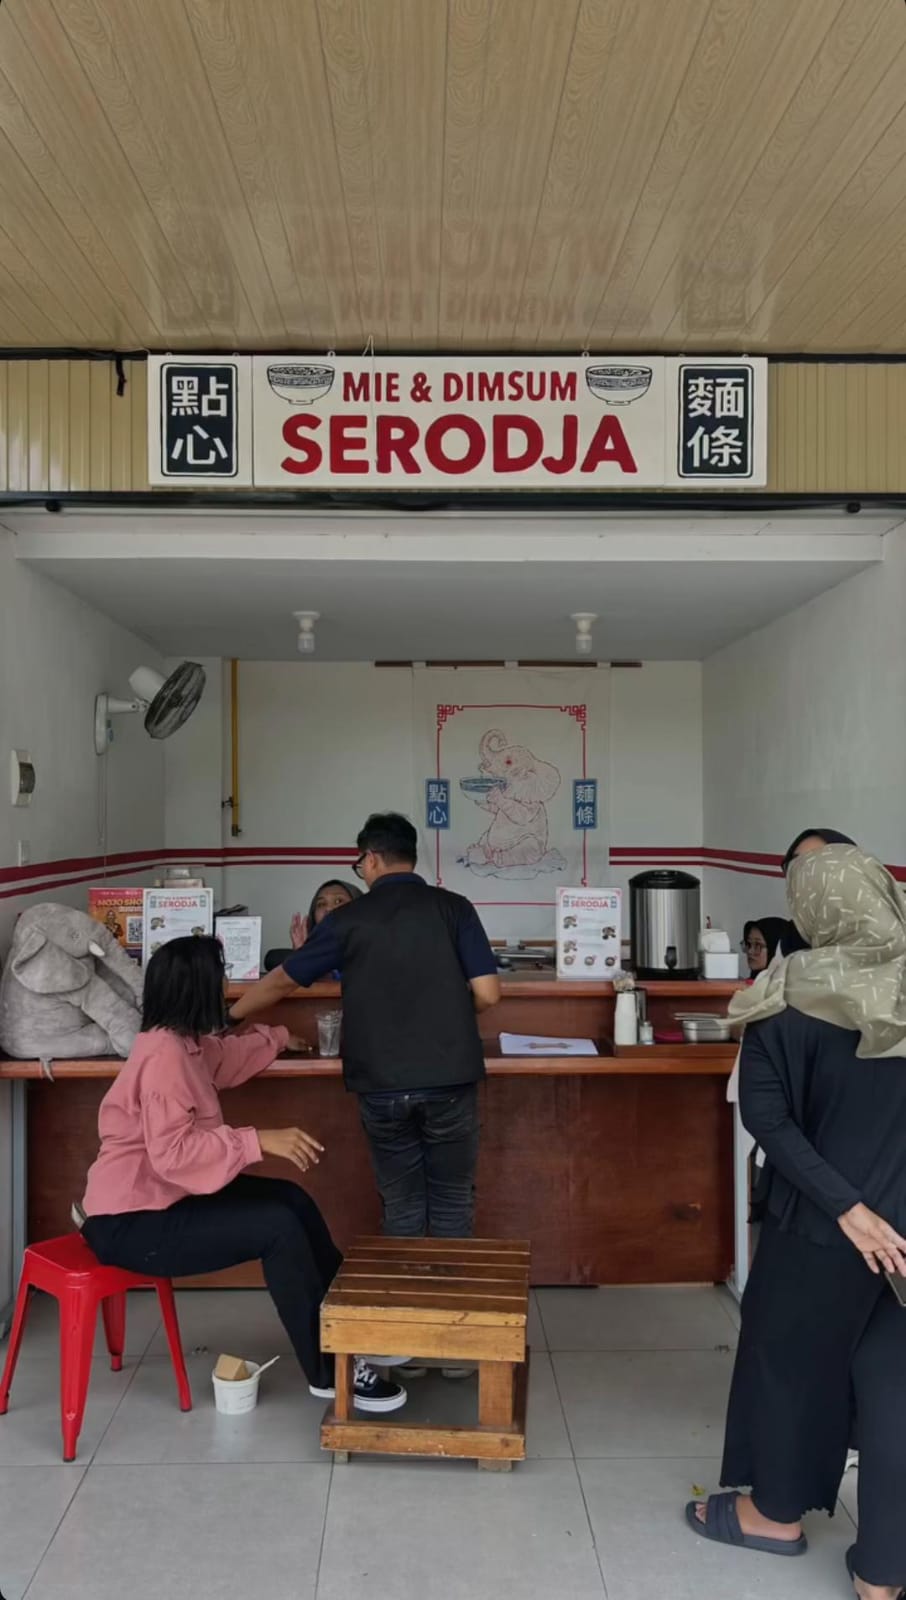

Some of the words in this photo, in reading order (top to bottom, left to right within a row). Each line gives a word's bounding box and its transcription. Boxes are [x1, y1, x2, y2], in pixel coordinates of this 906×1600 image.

[343, 372, 400, 403] MIE
[410, 372, 432, 403] &
[443, 371, 577, 402] DIMSUM
[171, 375, 229, 465] 點心
[687, 377, 744, 467] 麵條
[281, 413, 638, 475] SERODJA
[428, 783, 447, 825] 點心
[575, 784, 594, 825] 麵條
[158, 899, 197, 908] SERODJA
[570, 899, 609, 909] SERODJA
